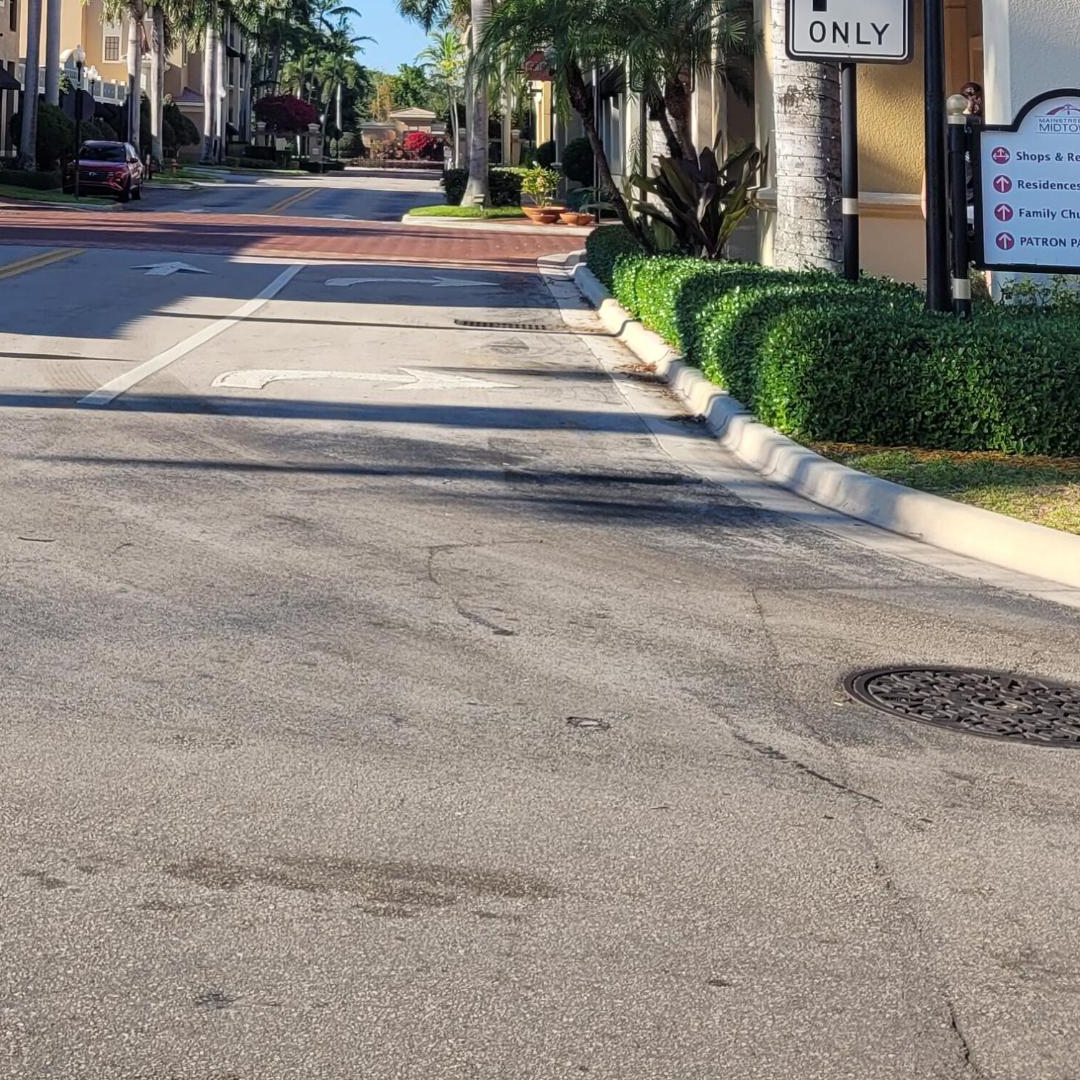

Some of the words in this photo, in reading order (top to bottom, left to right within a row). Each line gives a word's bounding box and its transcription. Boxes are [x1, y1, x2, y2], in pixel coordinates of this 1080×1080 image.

[809, 20, 890, 46] ONLY
[1039, 123, 1080, 133] MIDTO
[1016, 151, 1051, 163] Shops
[1055, 152, 1064, 162] &
[1019, 208, 1057, 220] Family
[1020, 237, 1066, 247] PATRON
